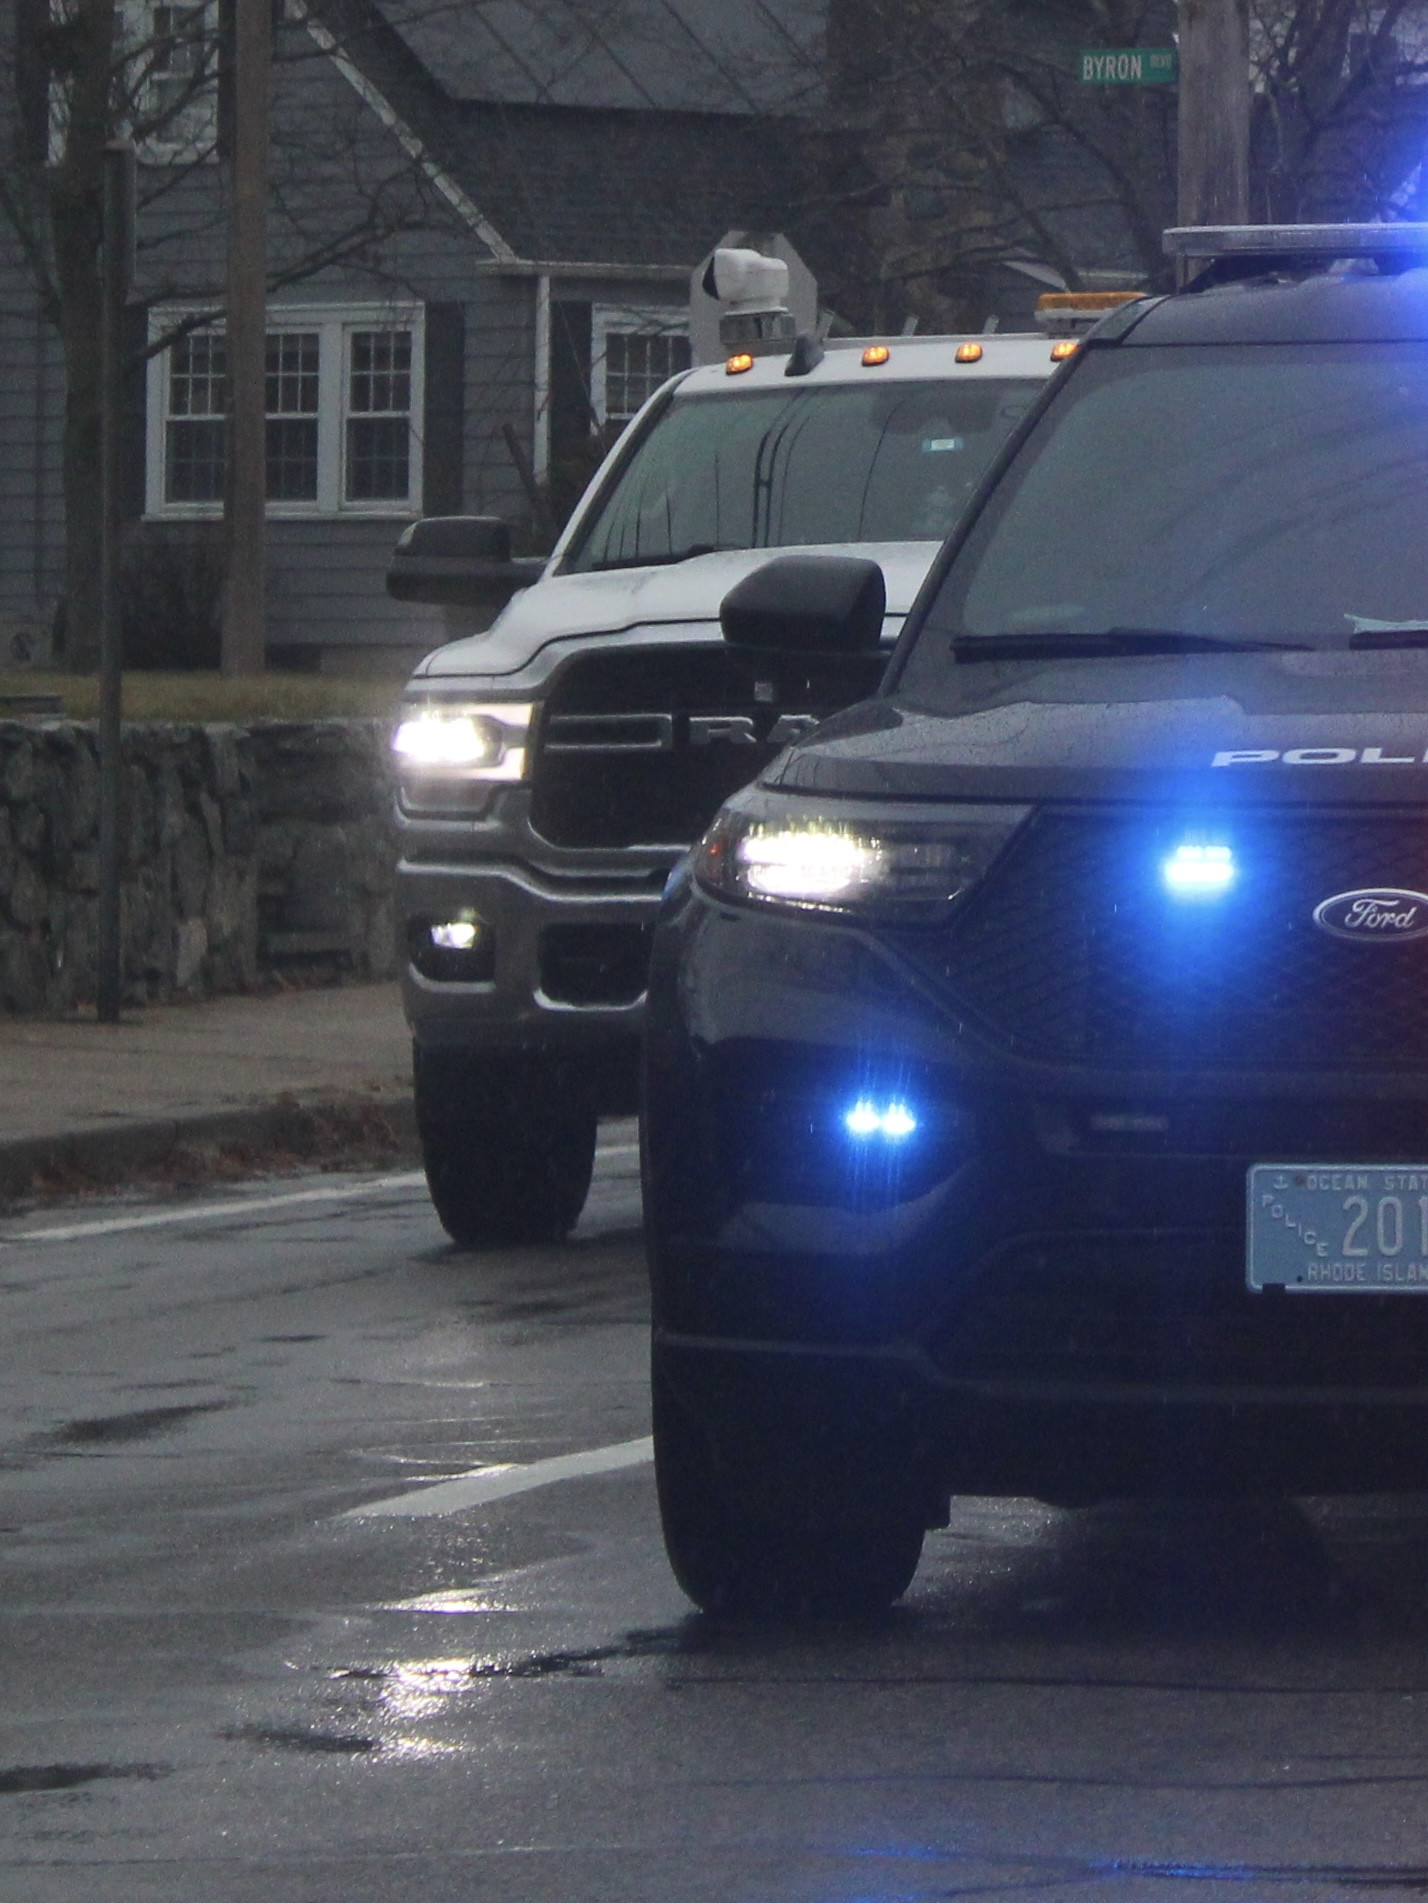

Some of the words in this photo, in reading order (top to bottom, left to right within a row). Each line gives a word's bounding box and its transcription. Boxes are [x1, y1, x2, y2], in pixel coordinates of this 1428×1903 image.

[1082, 54, 1142, 80] BYRON
[1344, 898, 1418, 928] Ford
[1306, 1175, 1368, 1191] OCEAN
[1262, 1195, 1329, 1257] POLICE
[1307, 1263, 1367, 1281] RHODE
